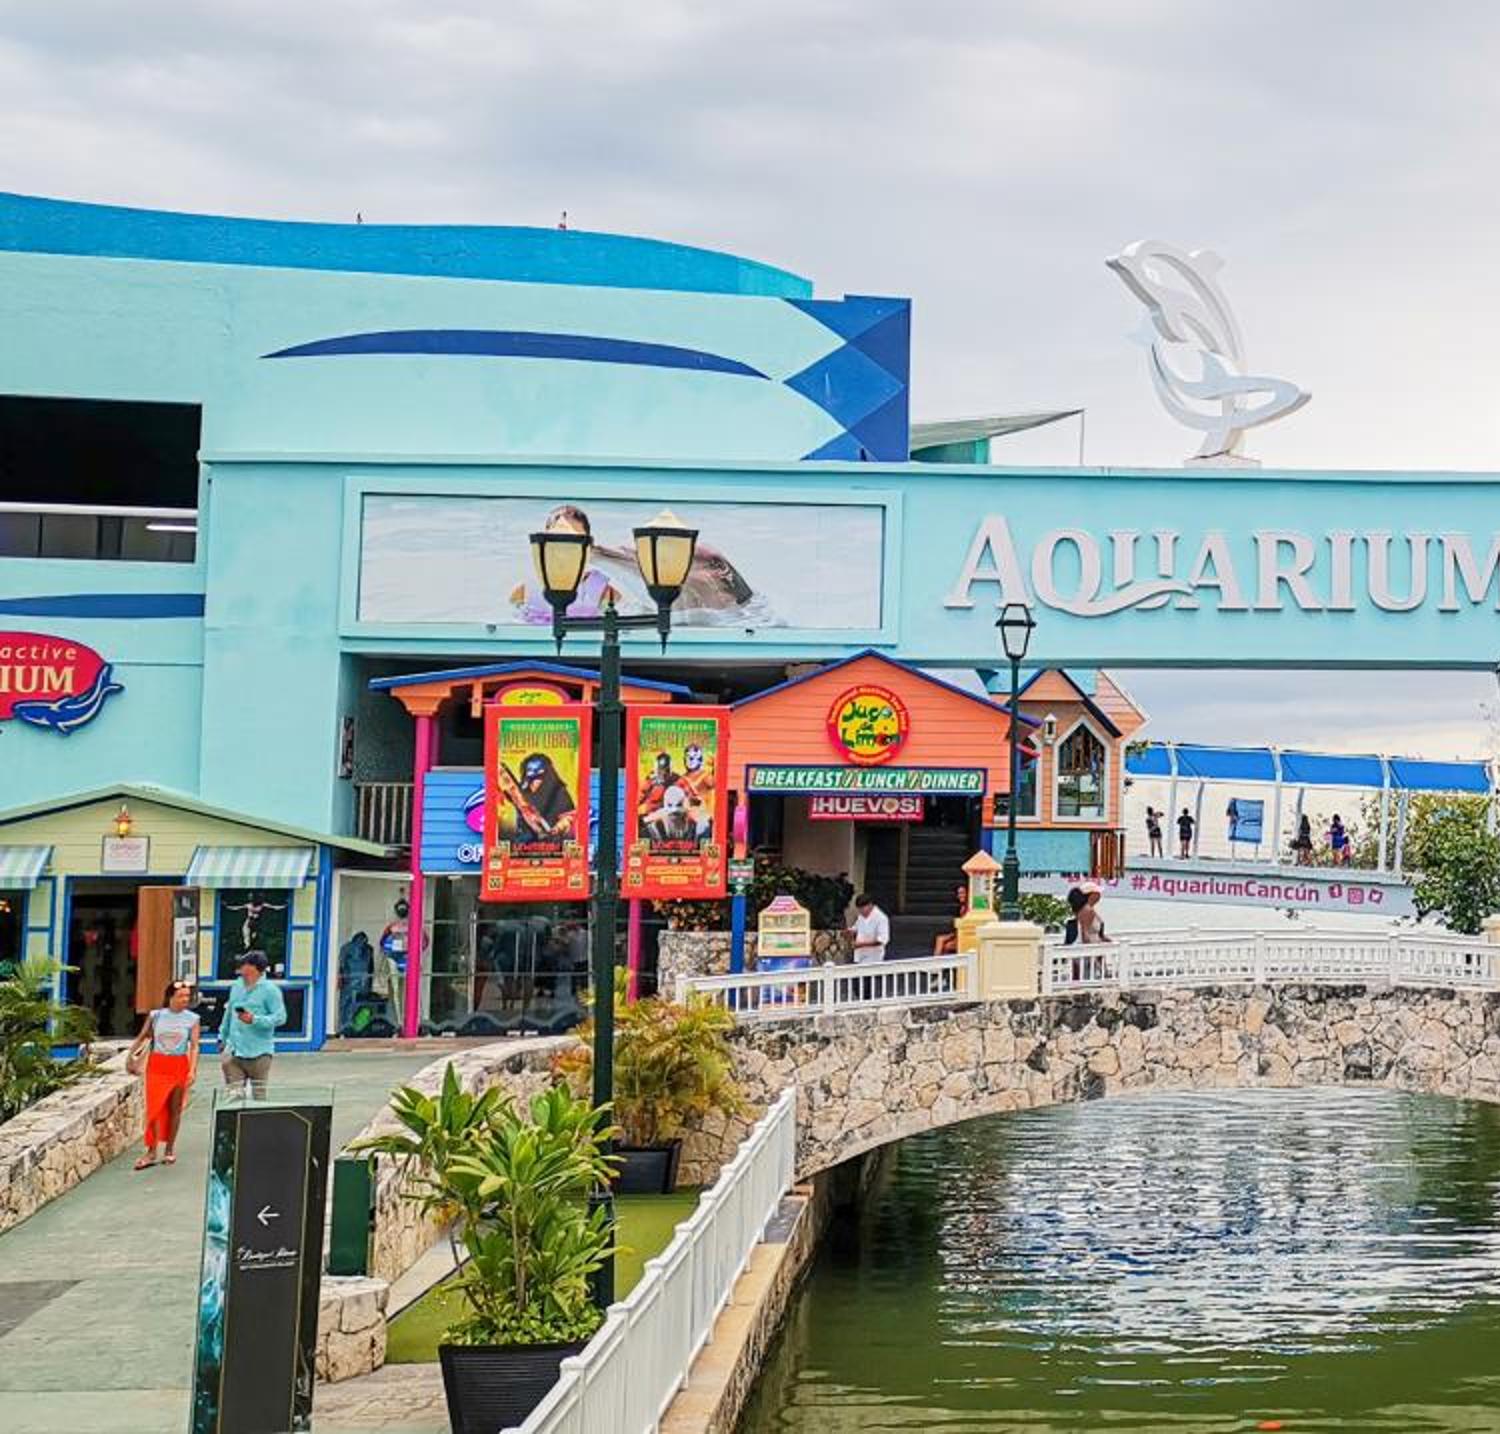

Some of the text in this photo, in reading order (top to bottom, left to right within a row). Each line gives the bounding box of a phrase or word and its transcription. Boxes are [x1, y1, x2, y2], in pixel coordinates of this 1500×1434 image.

[755, 769, 842, 788] BREAKFAST
[857, 771, 905, 788] LUNCH
[921, 772, 980, 789] DINNER
[1131, 874, 1320, 902] #AquariumCancún
